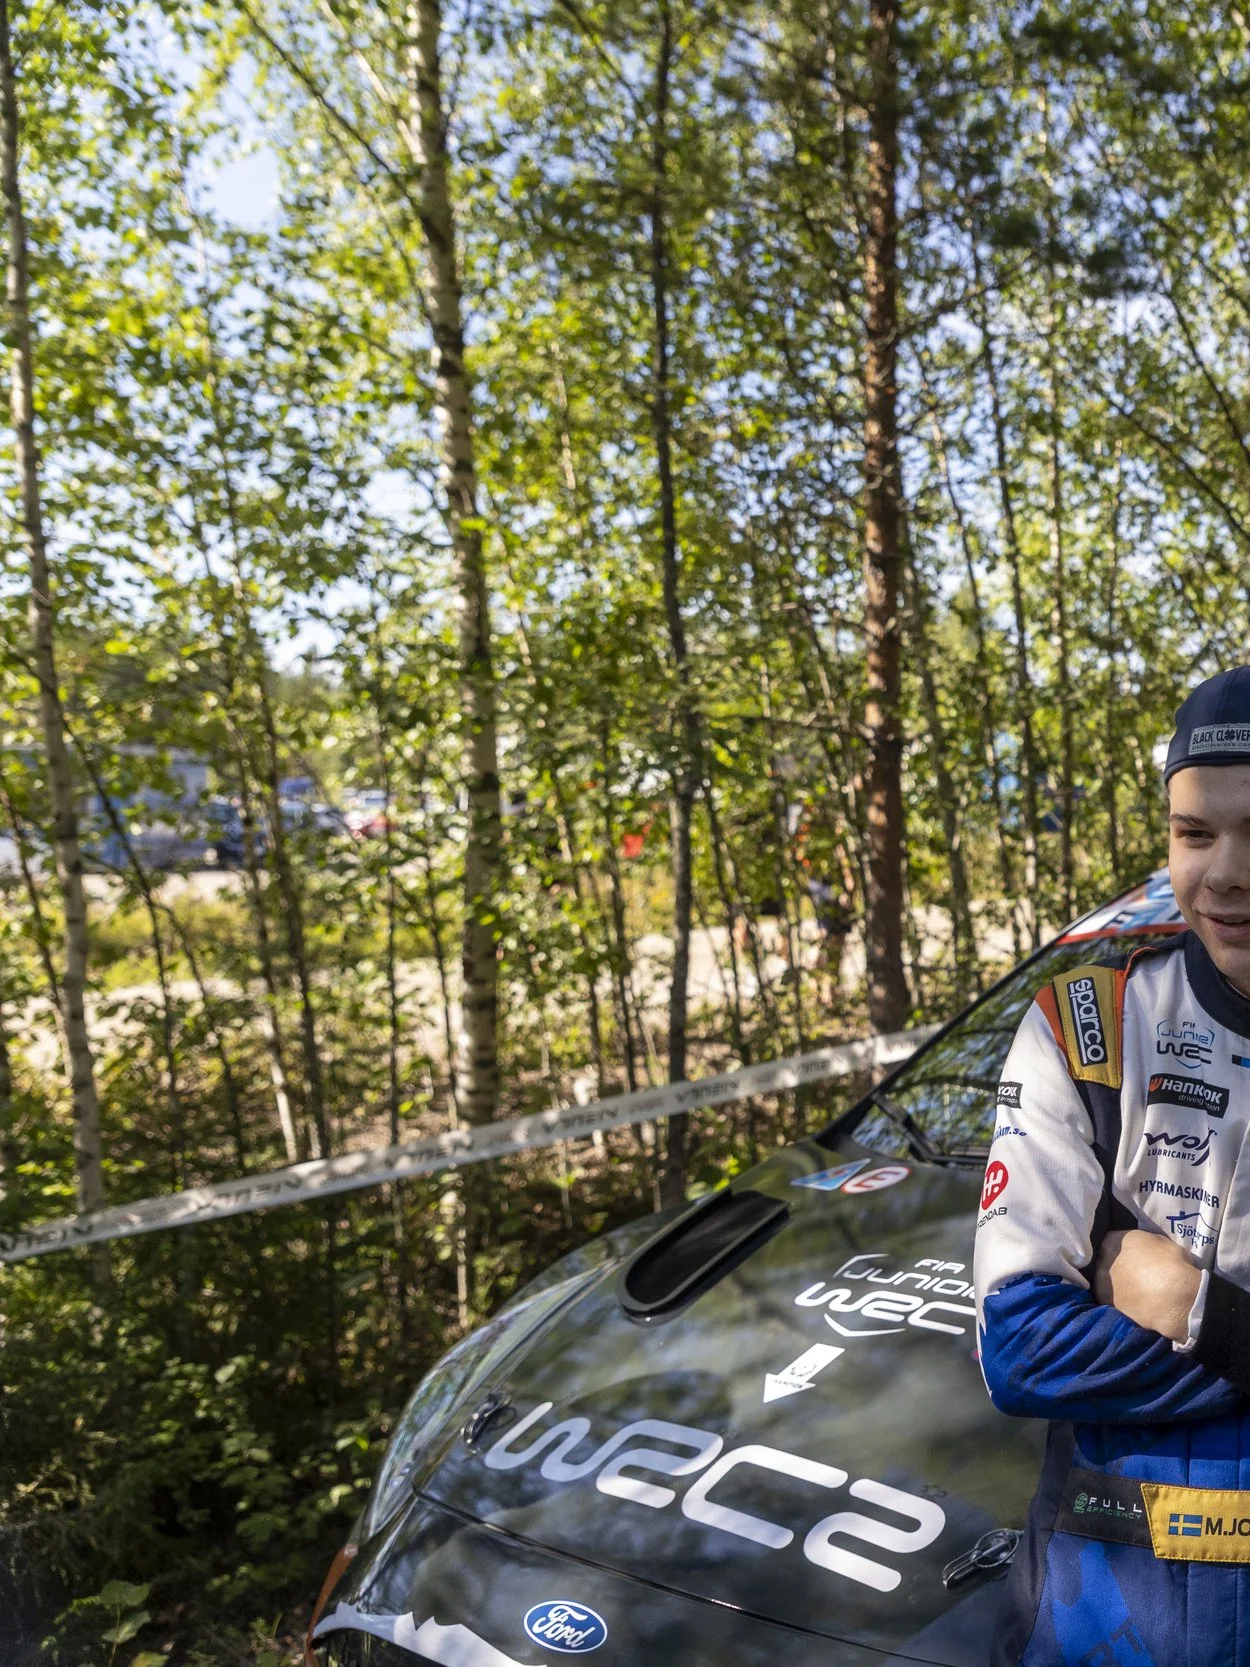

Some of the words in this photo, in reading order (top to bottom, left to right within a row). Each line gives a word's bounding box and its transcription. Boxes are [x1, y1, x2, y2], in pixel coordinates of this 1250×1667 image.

[1192, 730, 1214, 745] BLACK
[1070, 979, 1105, 1064] sparco
[1147, 1148, 1196, 1161] LUBRICANTS
[914, 1258, 966, 1274] FIA
[485, 1401, 947, 1593] WRC2
[531, 1604, 596, 1648] Ford
